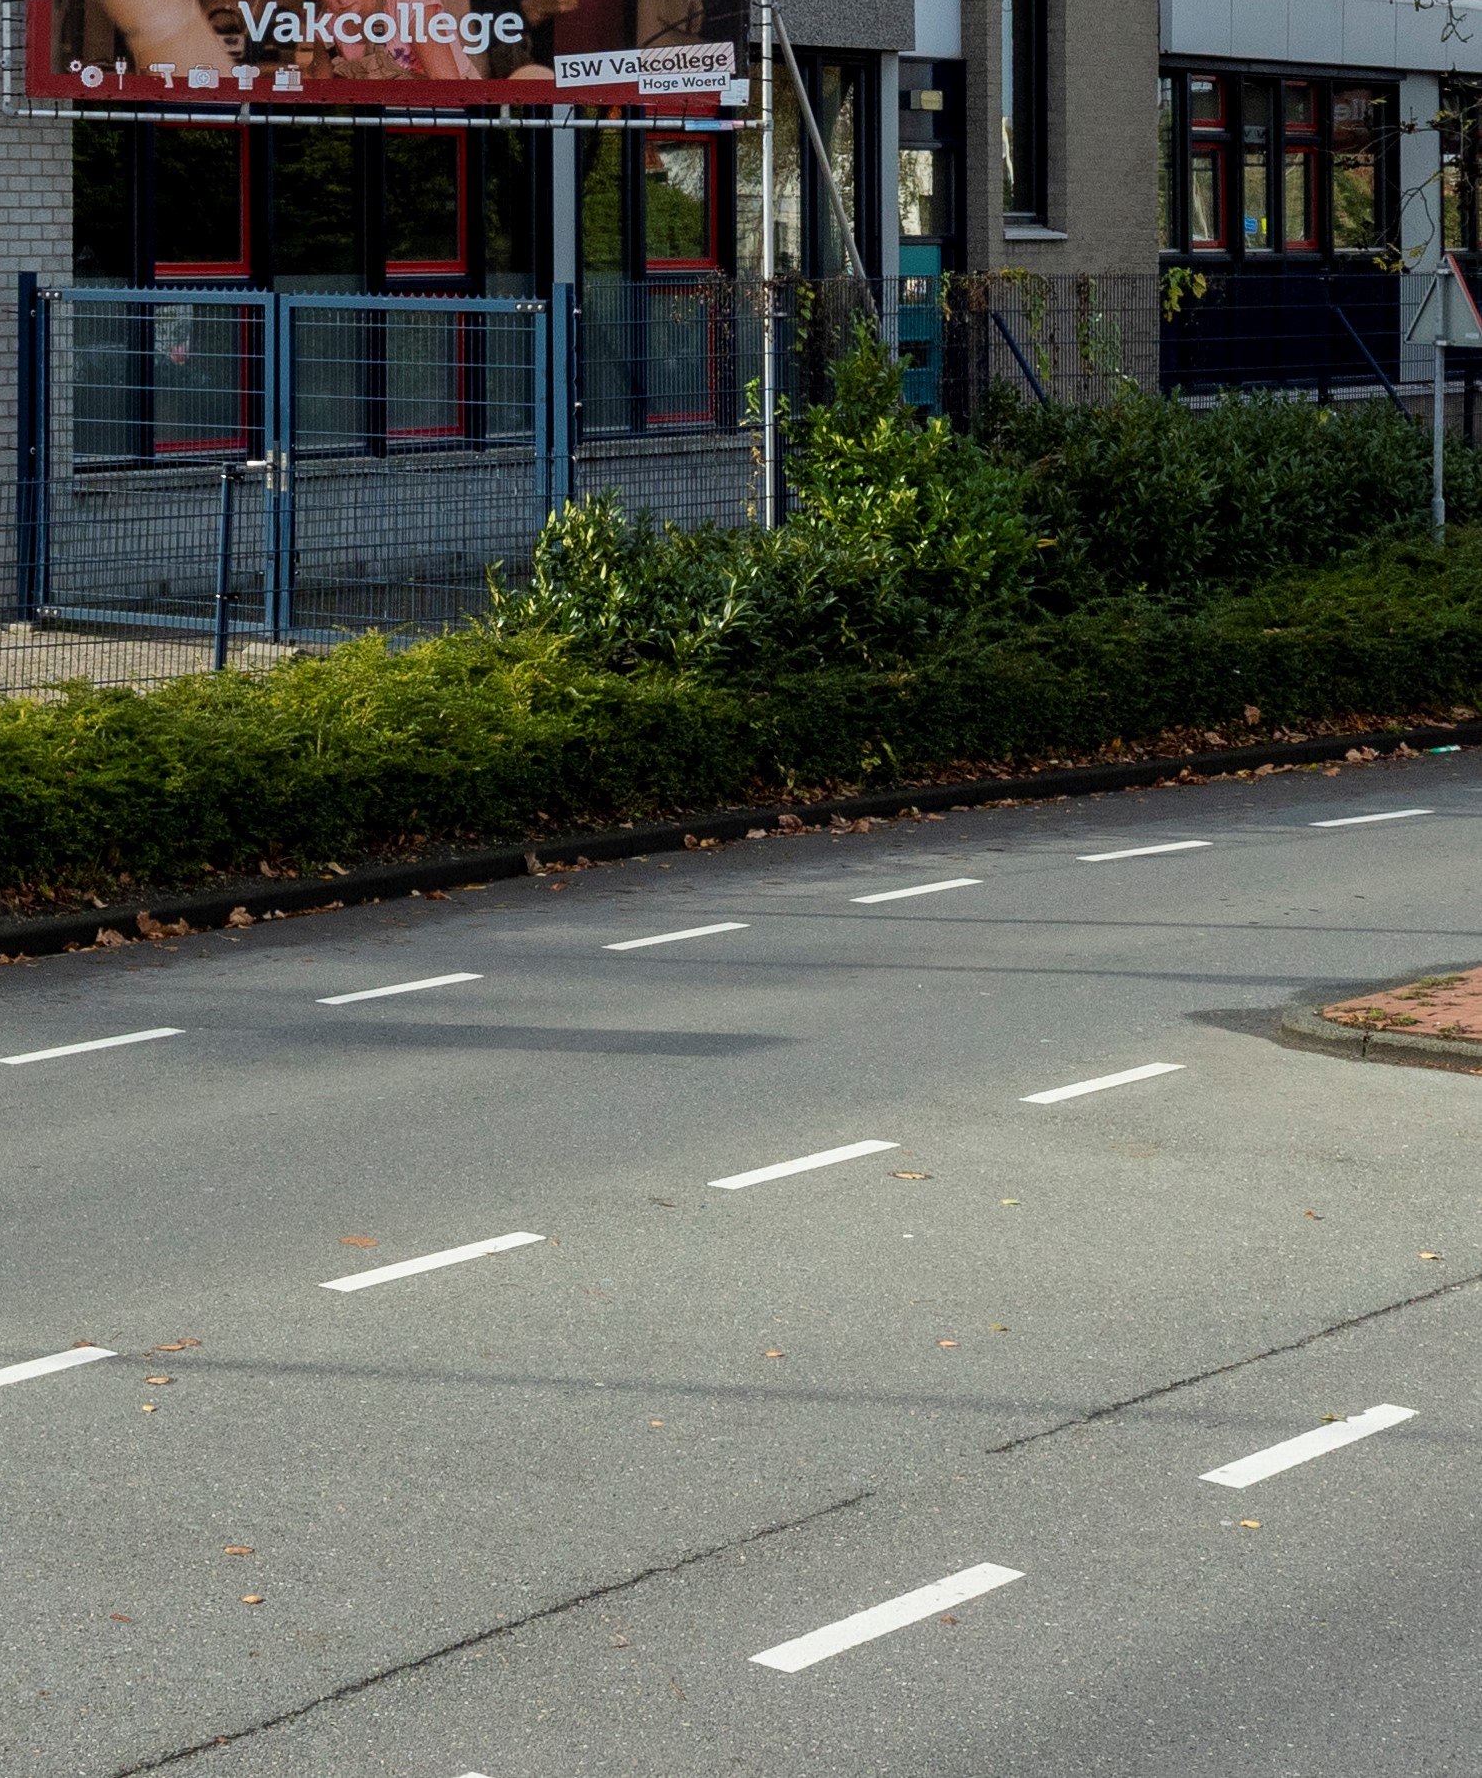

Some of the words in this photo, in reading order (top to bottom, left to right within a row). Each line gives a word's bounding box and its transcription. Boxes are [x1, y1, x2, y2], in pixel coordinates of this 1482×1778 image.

[238, 1, 524, 54] Vakcollege
[560, 60, 603, 79] ISW
[610, 53, 728, 74] Vakcollege
[642, 78, 679, 91] Hoge
[682, 76, 726, 88] Woerd
